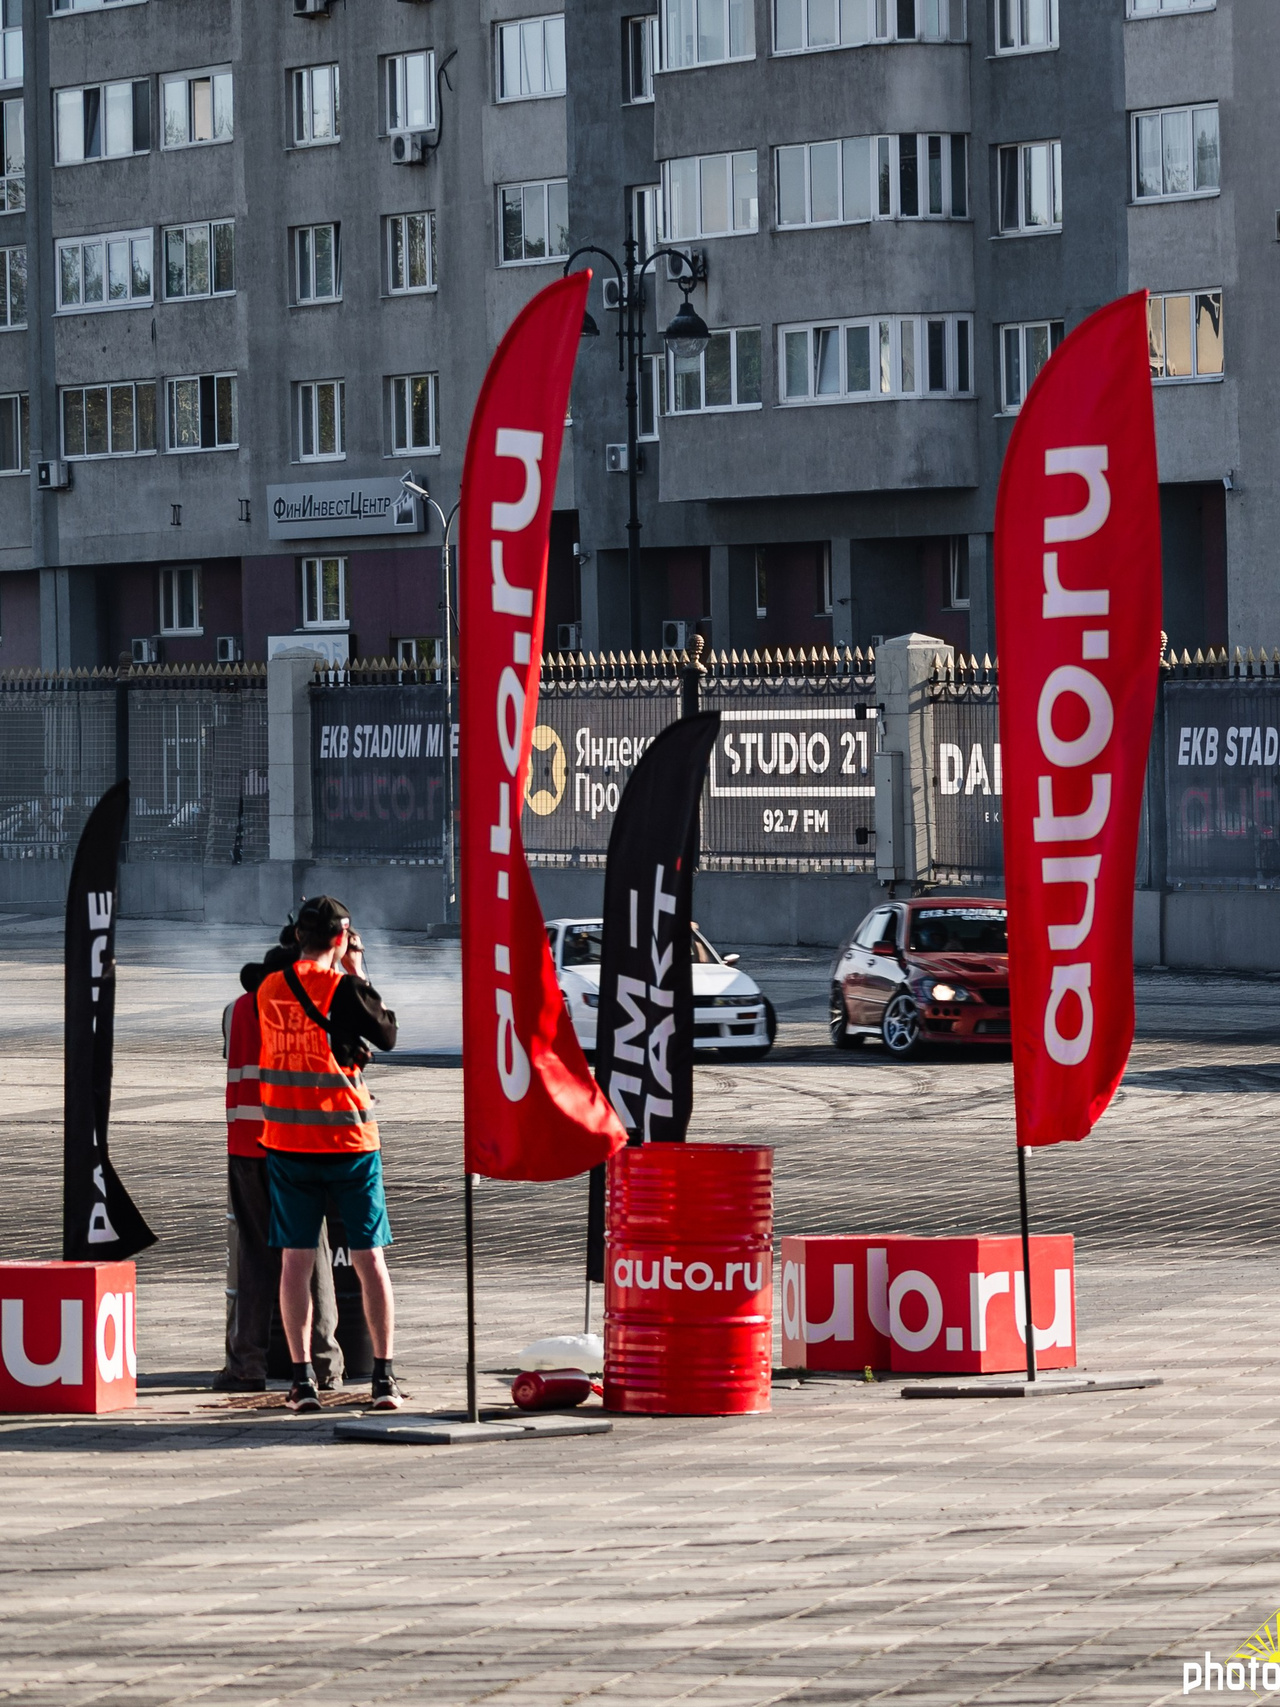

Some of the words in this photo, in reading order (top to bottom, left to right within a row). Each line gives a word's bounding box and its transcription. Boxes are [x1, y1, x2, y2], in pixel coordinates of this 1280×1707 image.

[319, 725, 349, 759] EKB
[352, 724, 422, 759] STADIUM
[723, 731, 831, 776] STUDIO
[840, 731, 868, 775] 21
[1033, 444, 1114, 1066] auto.ru
[1178, 726, 1219, 766] EKB
[575, 772, 620, 820] Про
[762, 809, 798, 833] 92.7
[803, 809, 829, 833] FM
[613, 1256, 763, 1291] auto.ru
